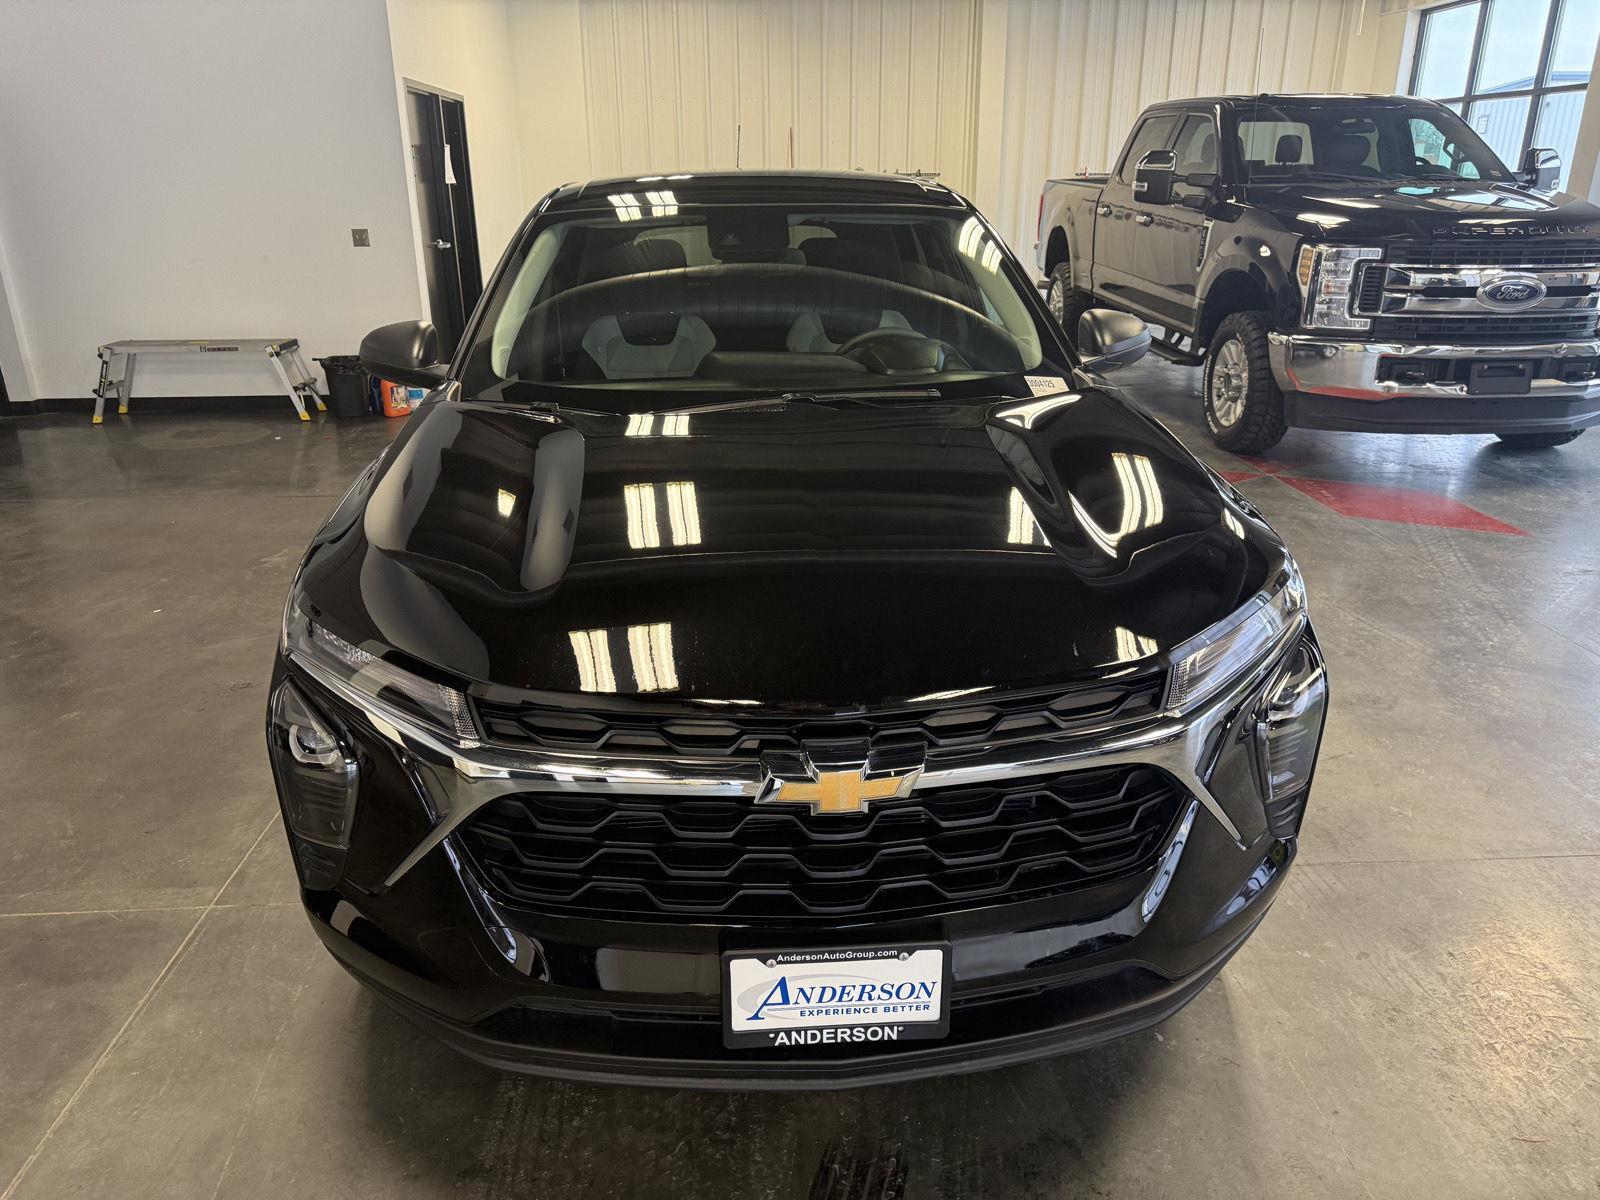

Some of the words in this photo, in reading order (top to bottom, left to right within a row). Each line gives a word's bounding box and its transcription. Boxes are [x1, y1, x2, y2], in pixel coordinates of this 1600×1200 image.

[1496, 284, 1530, 301] Ford
[776, 949, 898, 963] AndersonAutoGroup.com
[745, 976, 938, 1020] ANDERSON
[799, 1006, 878, 1017] EXPERIENCE
[883, 1004, 931, 1013] BETTER
[774, 1026, 898, 1047] ANDERSON
